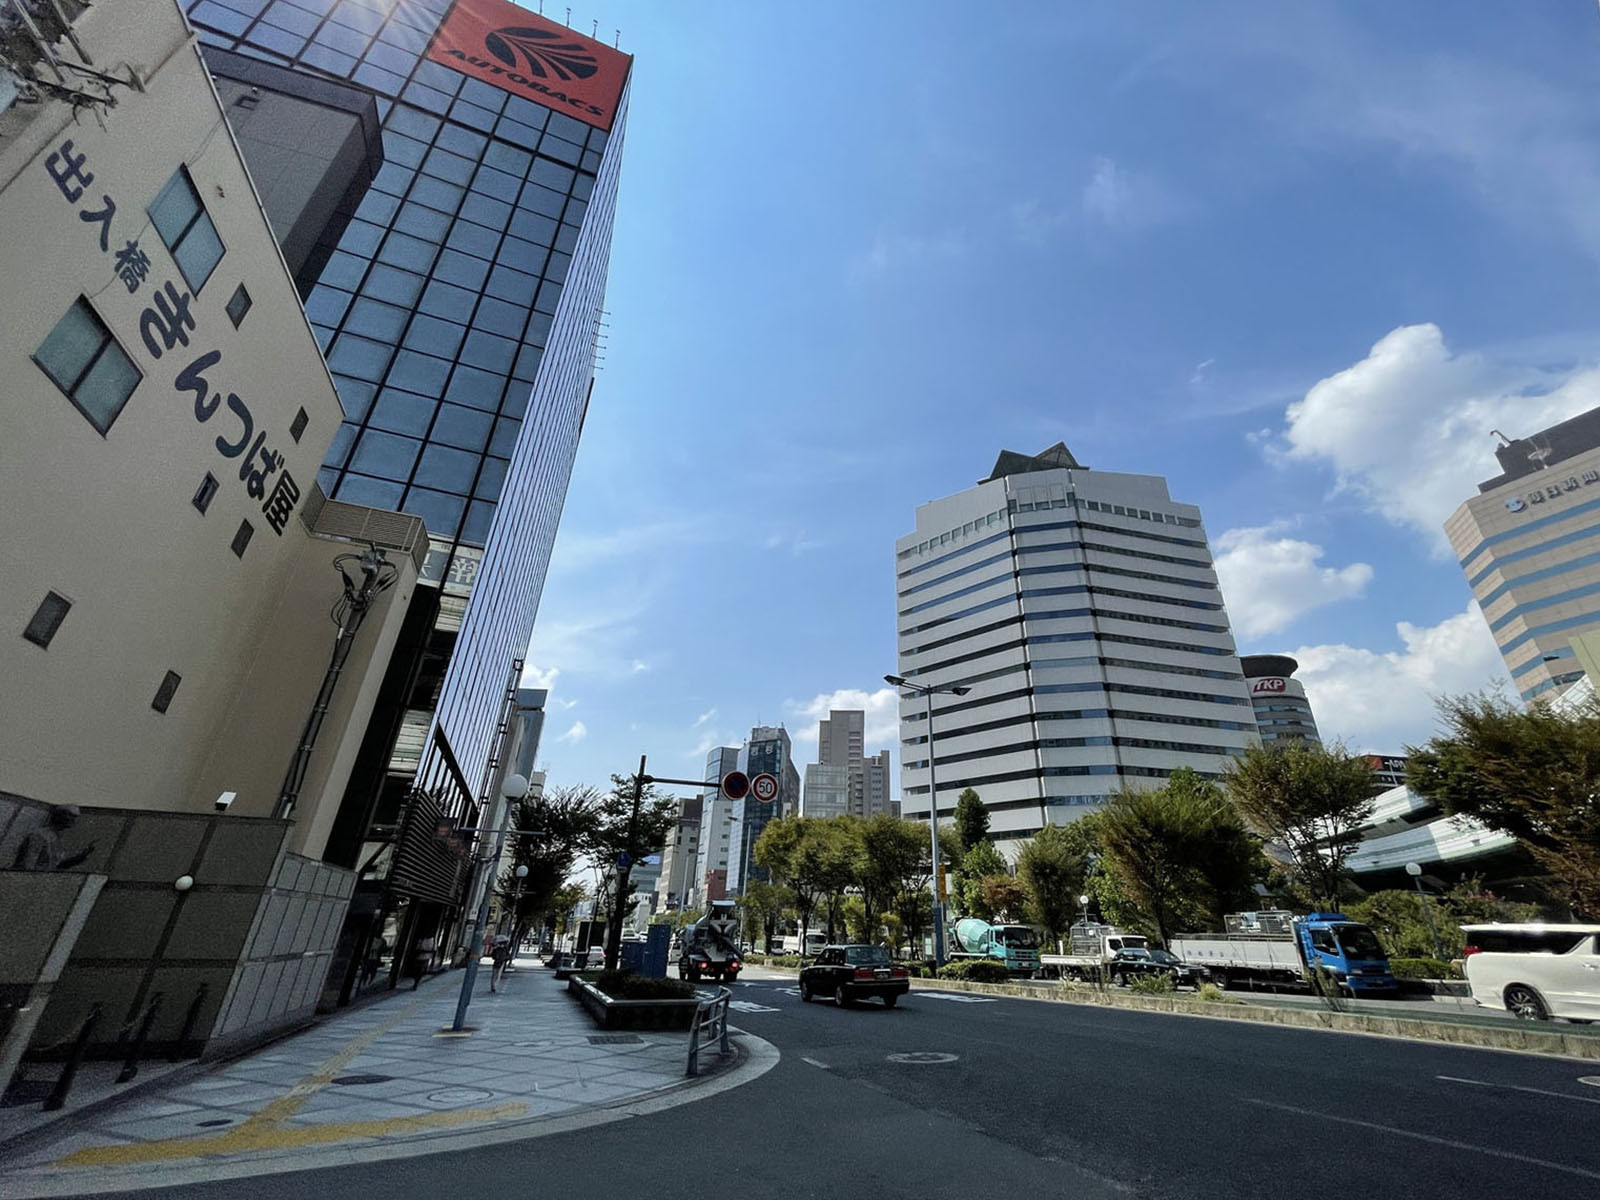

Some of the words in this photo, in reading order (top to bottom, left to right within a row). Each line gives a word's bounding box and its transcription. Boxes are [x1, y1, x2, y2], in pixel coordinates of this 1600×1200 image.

[447, 49, 604, 117] AUTOBACS
[1255, 679, 1284, 691] TKP
[759, 781, 773, 794] 50
